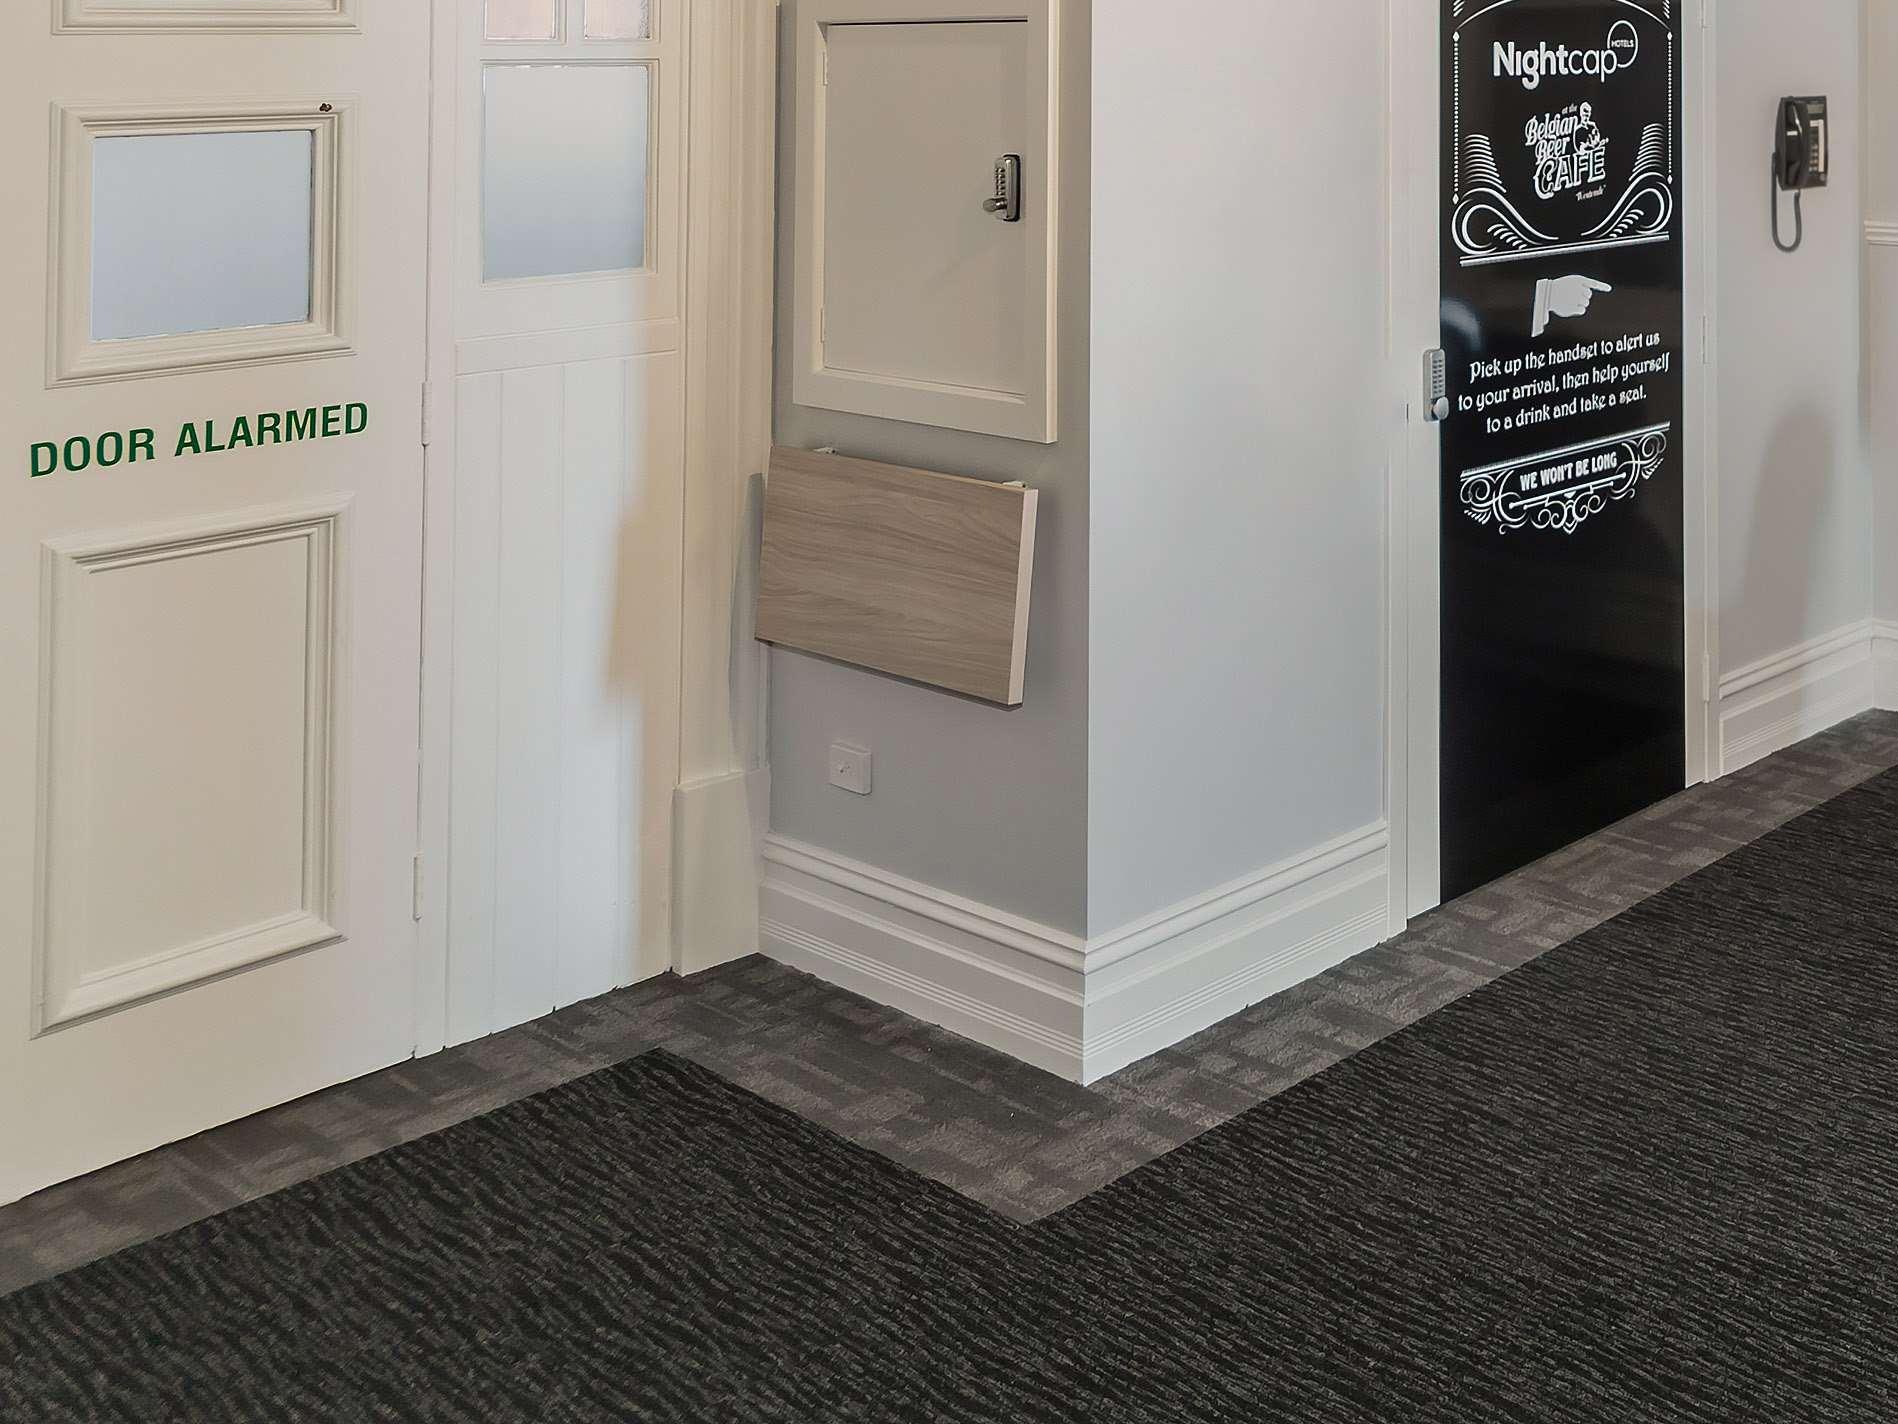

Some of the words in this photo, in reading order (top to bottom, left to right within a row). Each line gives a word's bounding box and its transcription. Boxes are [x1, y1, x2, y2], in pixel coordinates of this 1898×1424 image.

[1493, 41, 1617, 90] Nightcap
[1611, 39, 1634, 48] HOTELS
[1525, 113, 1578, 147] Belgian
[1535, 137, 1570, 165] Beer
[1458, 394, 1473, 411] to
[1476, 388, 1510, 411] your
[1512, 375, 1560, 401] arrival,
[1562, 371, 1589, 391] then
[1592, 364, 1619, 384] help
[1621, 352, 1670, 382] yourself
[1469, 358, 1502, 384] Pick
[1504, 358, 1522, 375] up
[1525, 352, 1545, 370] the
[1549, 342, 1597, 366] handset
[1601, 339, 1613, 355] to
[1616, 333, 1643, 353] alert
[1646, 332, 1660, 347] us
[1486, 417, 1501, 434] to
[1503, 417, 1513, 430] a
[1515, 404, 1550, 428] drink
[1552, 397, 1577, 419] and
[1580, 392, 1606, 412] take
[1608, 393, 1617, 406] a
[1619, 384, 1647, 405] seat.
[30, 428, 156, 478] DOOR
[174, 401, 369, 457] ALARMED
[1520, 471, 1538, 492] WE
[1540, 462, 1573, 486] WON'T
[1575, 458, 1590, 478] BE
[1591, 451, 1617, 473] LONG
